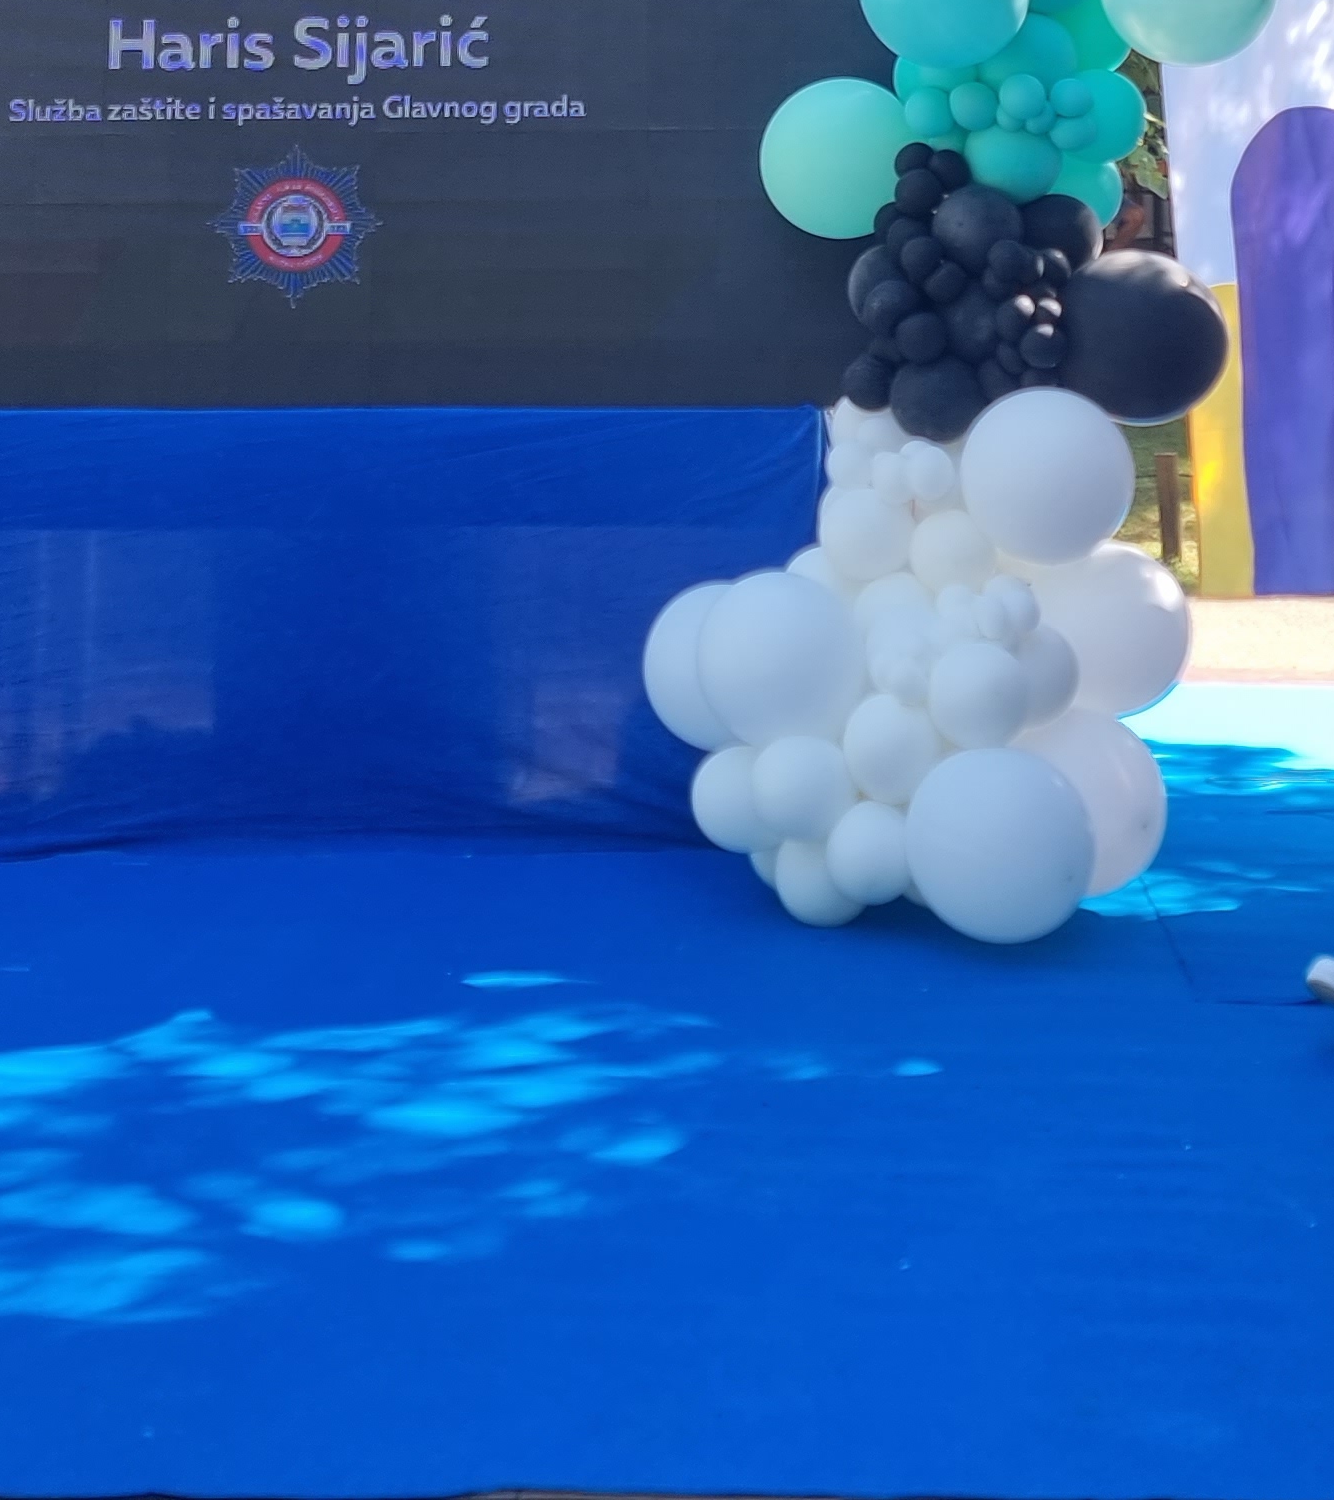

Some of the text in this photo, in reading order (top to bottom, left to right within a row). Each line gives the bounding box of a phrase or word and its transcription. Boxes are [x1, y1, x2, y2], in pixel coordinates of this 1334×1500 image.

[108, 14, 490, 85] Haris Sijarić
[8, 94, 587, 127] Služba zaštite i spašavanja Glavnog grada
